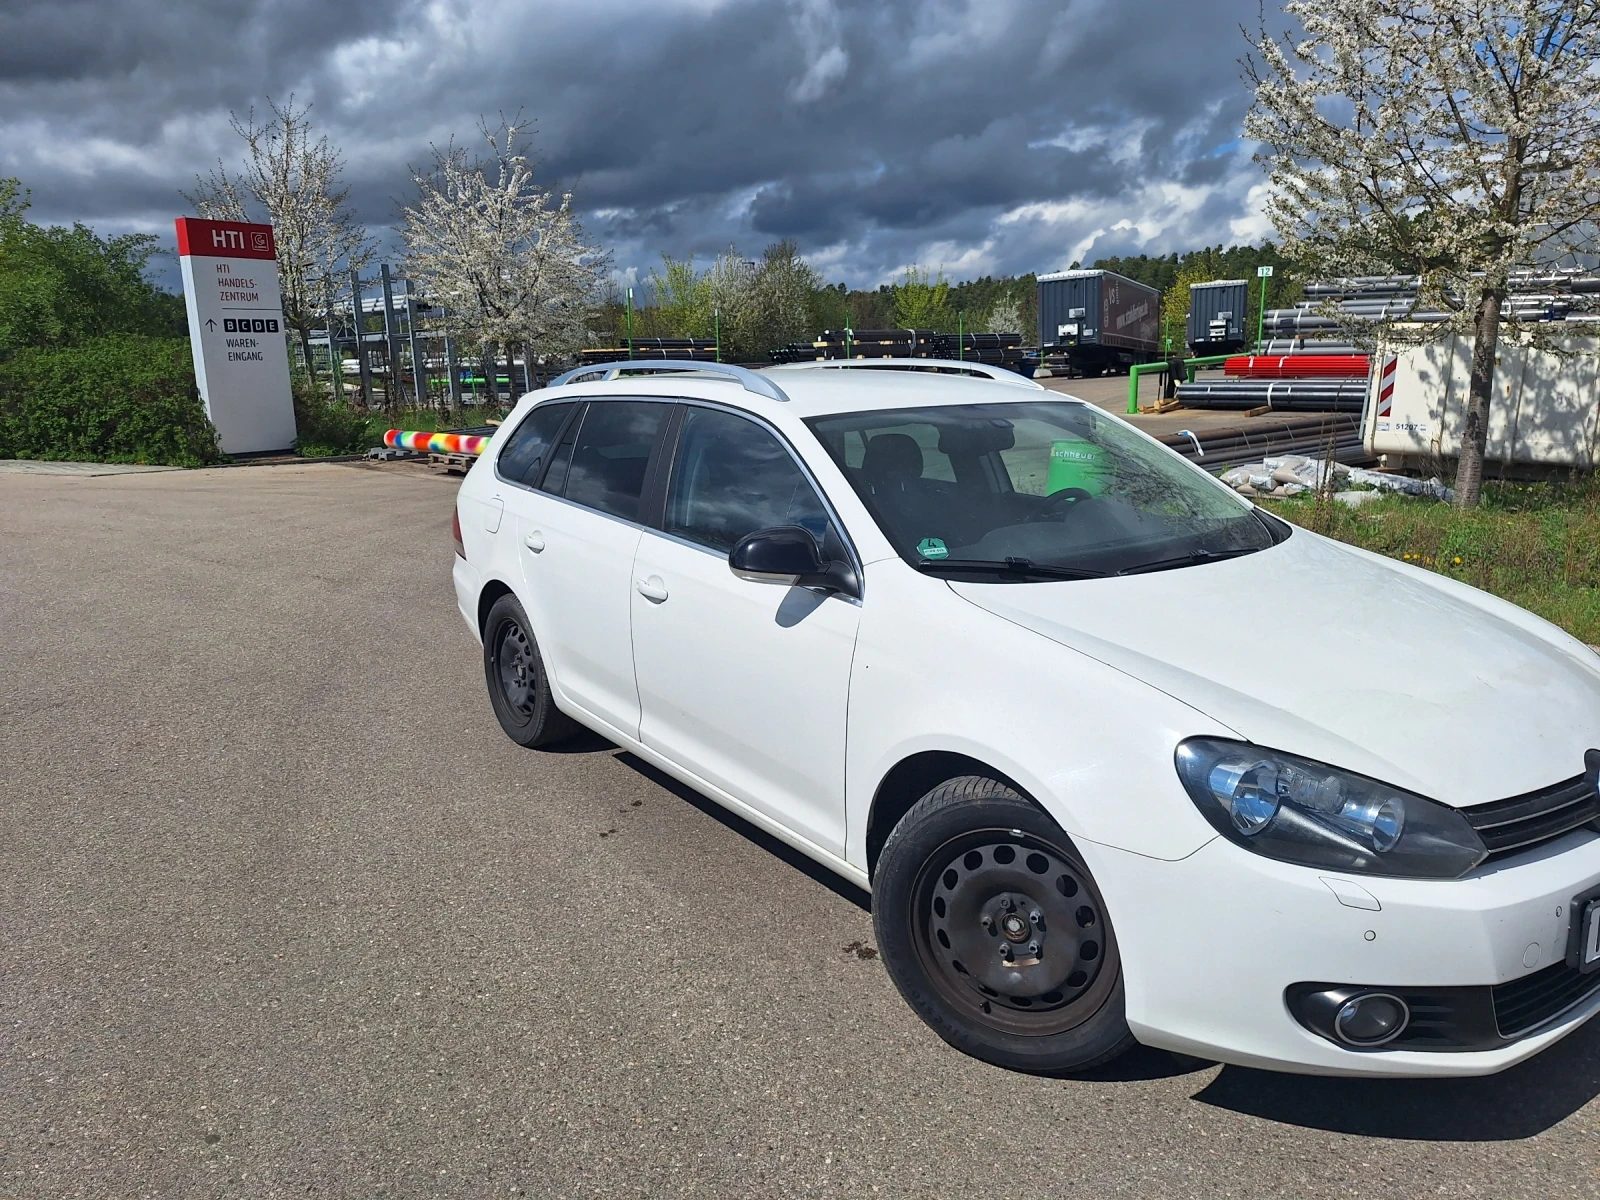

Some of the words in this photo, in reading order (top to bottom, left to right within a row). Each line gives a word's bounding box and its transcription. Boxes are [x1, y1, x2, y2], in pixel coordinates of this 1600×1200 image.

[211, 229, 245, 249] HTI
[216, 263, 230, 274] HTI
[1261, 267, 1271, 276] 12
[217, 277, 258, 289] HANDELS-
[219, 291, 259, 302] ZENTRUM
[225, 338, 260, 348] WAREN-
[227, 351, 264, 362] EINGANG
[1395, 423, 1418, 431] 51207
[927, 538, 937, 548] 4
